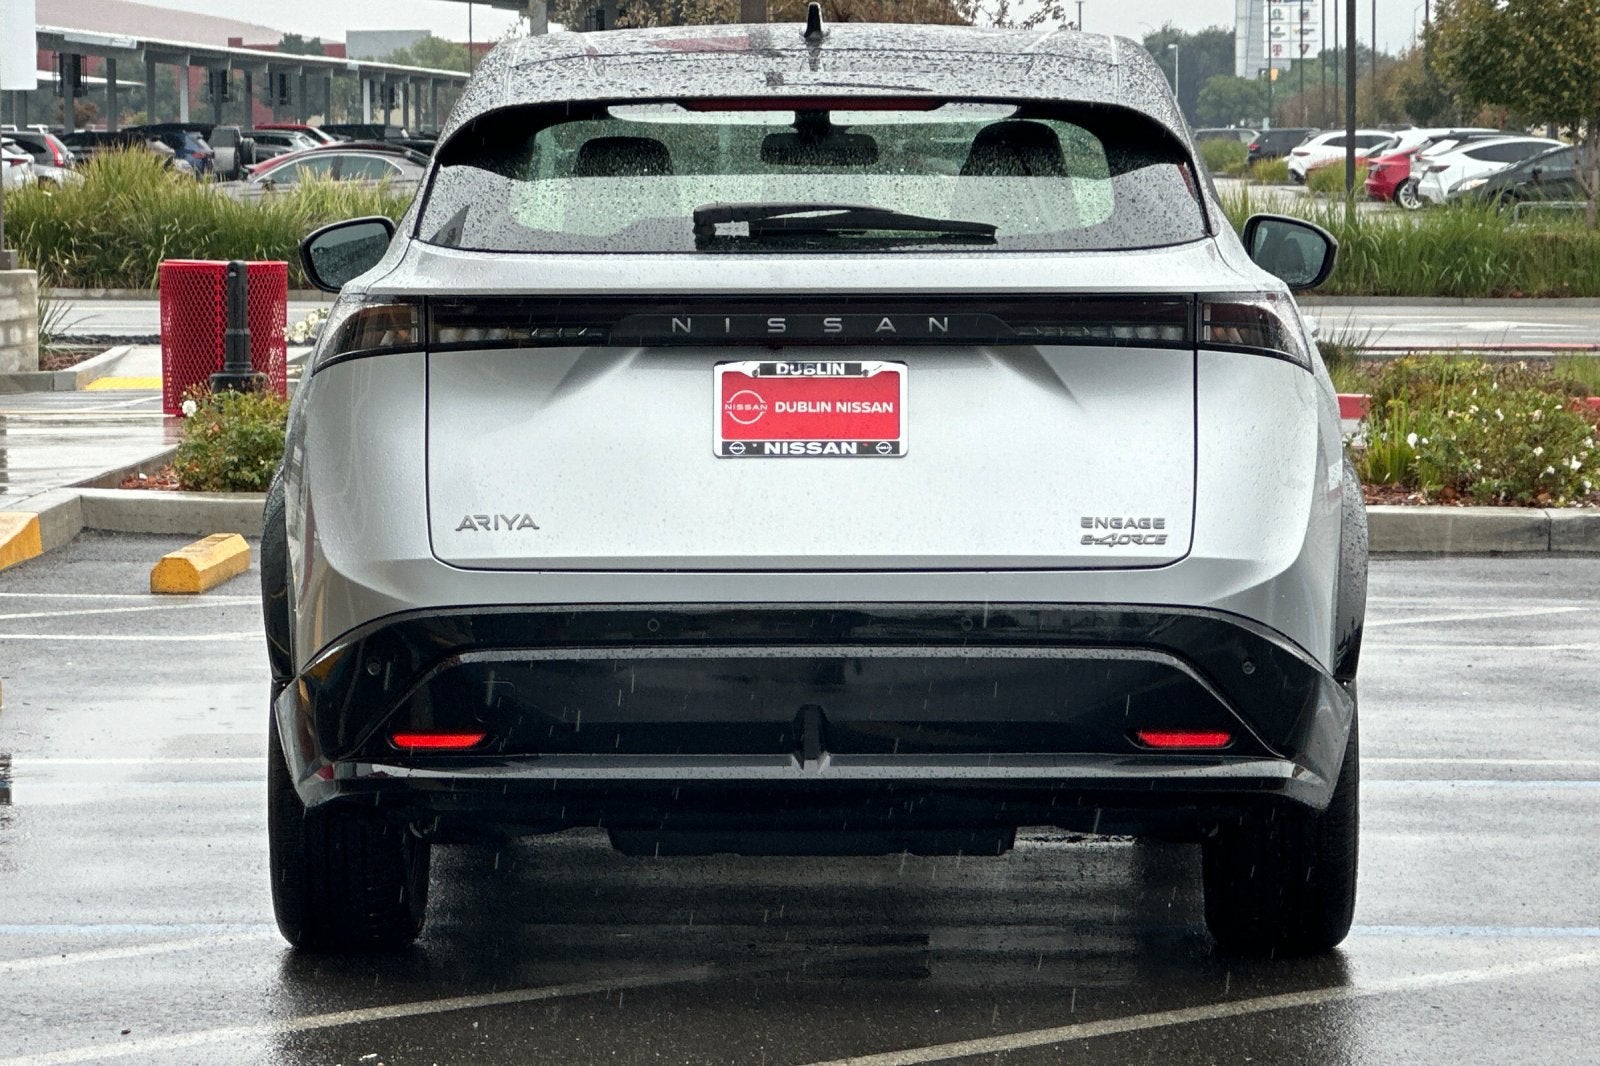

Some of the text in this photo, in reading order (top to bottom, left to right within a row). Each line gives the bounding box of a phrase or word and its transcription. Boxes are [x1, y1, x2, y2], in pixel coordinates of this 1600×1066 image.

[671, 317, 949, 333] NISSAN
[776, 362, 845, 375] DUBLIN
[725, 403, 768, 411] NISSAN
[775, 401, 893, 413] DUBLIN NISSAN
[764, 442, 857, 454] NISSAN
[455, 513, 540, 531] ARIYA
[1080, 516, 1166, 529] ENGAGE
